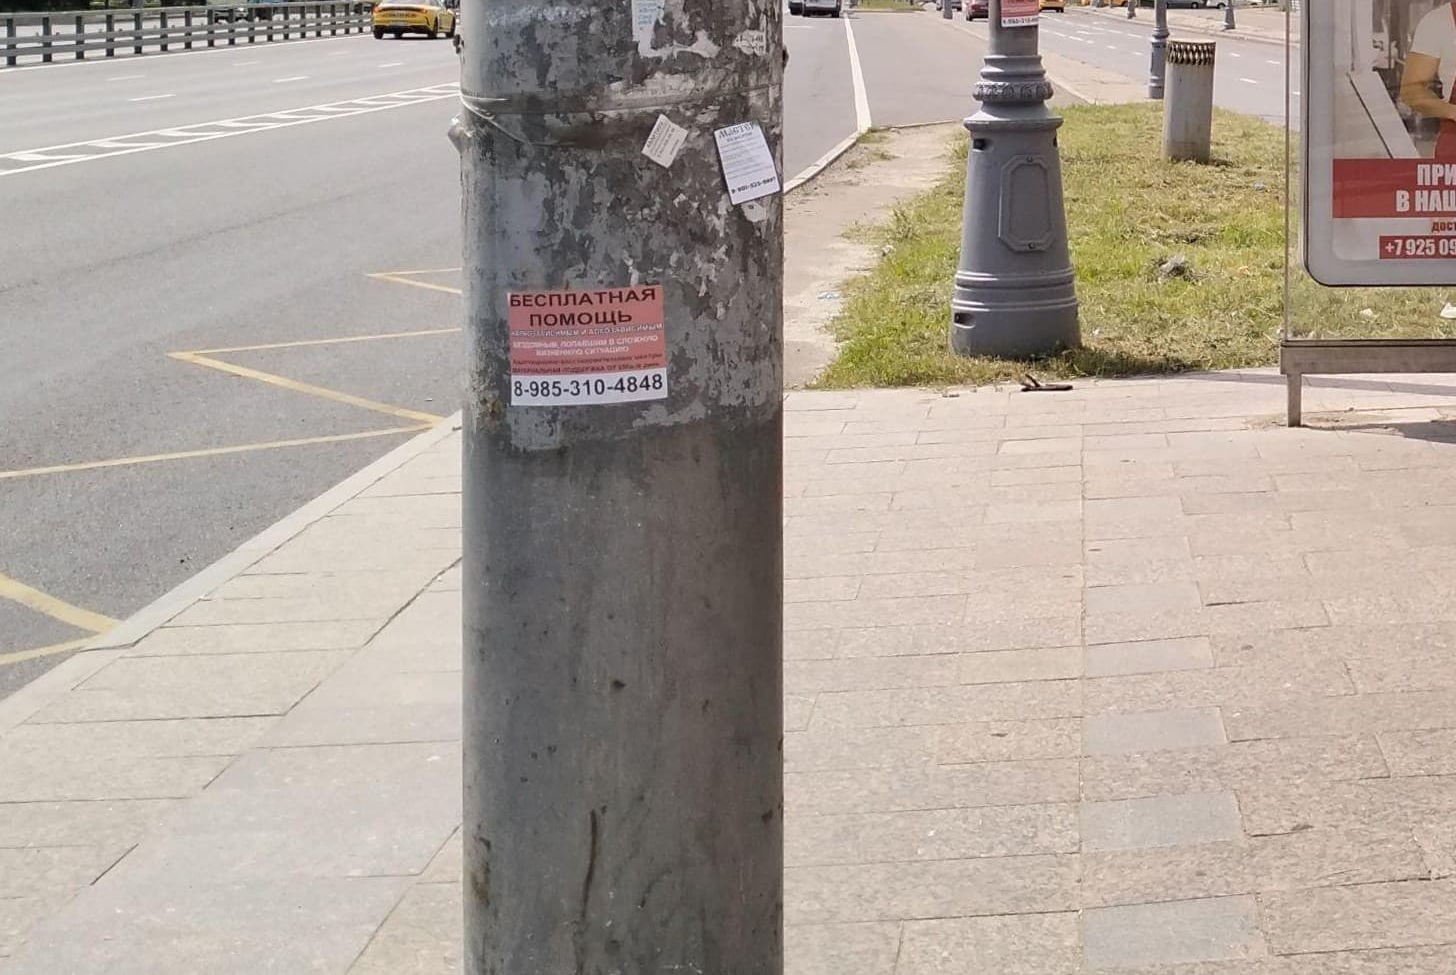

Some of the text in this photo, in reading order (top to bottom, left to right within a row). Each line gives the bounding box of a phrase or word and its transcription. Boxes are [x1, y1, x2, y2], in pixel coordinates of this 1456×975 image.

[1396, 190, 1410, 212] В
[1384, 239, 1404, 256] +7
[1405, 238, 1436, 256] 925
[510, 288, 656, 307] БЕСПЛАТНАЯ
[529, 310, 633, 327] ПОМОЩЬ
[513, 373, 664, 398] 8-985-310-4848
